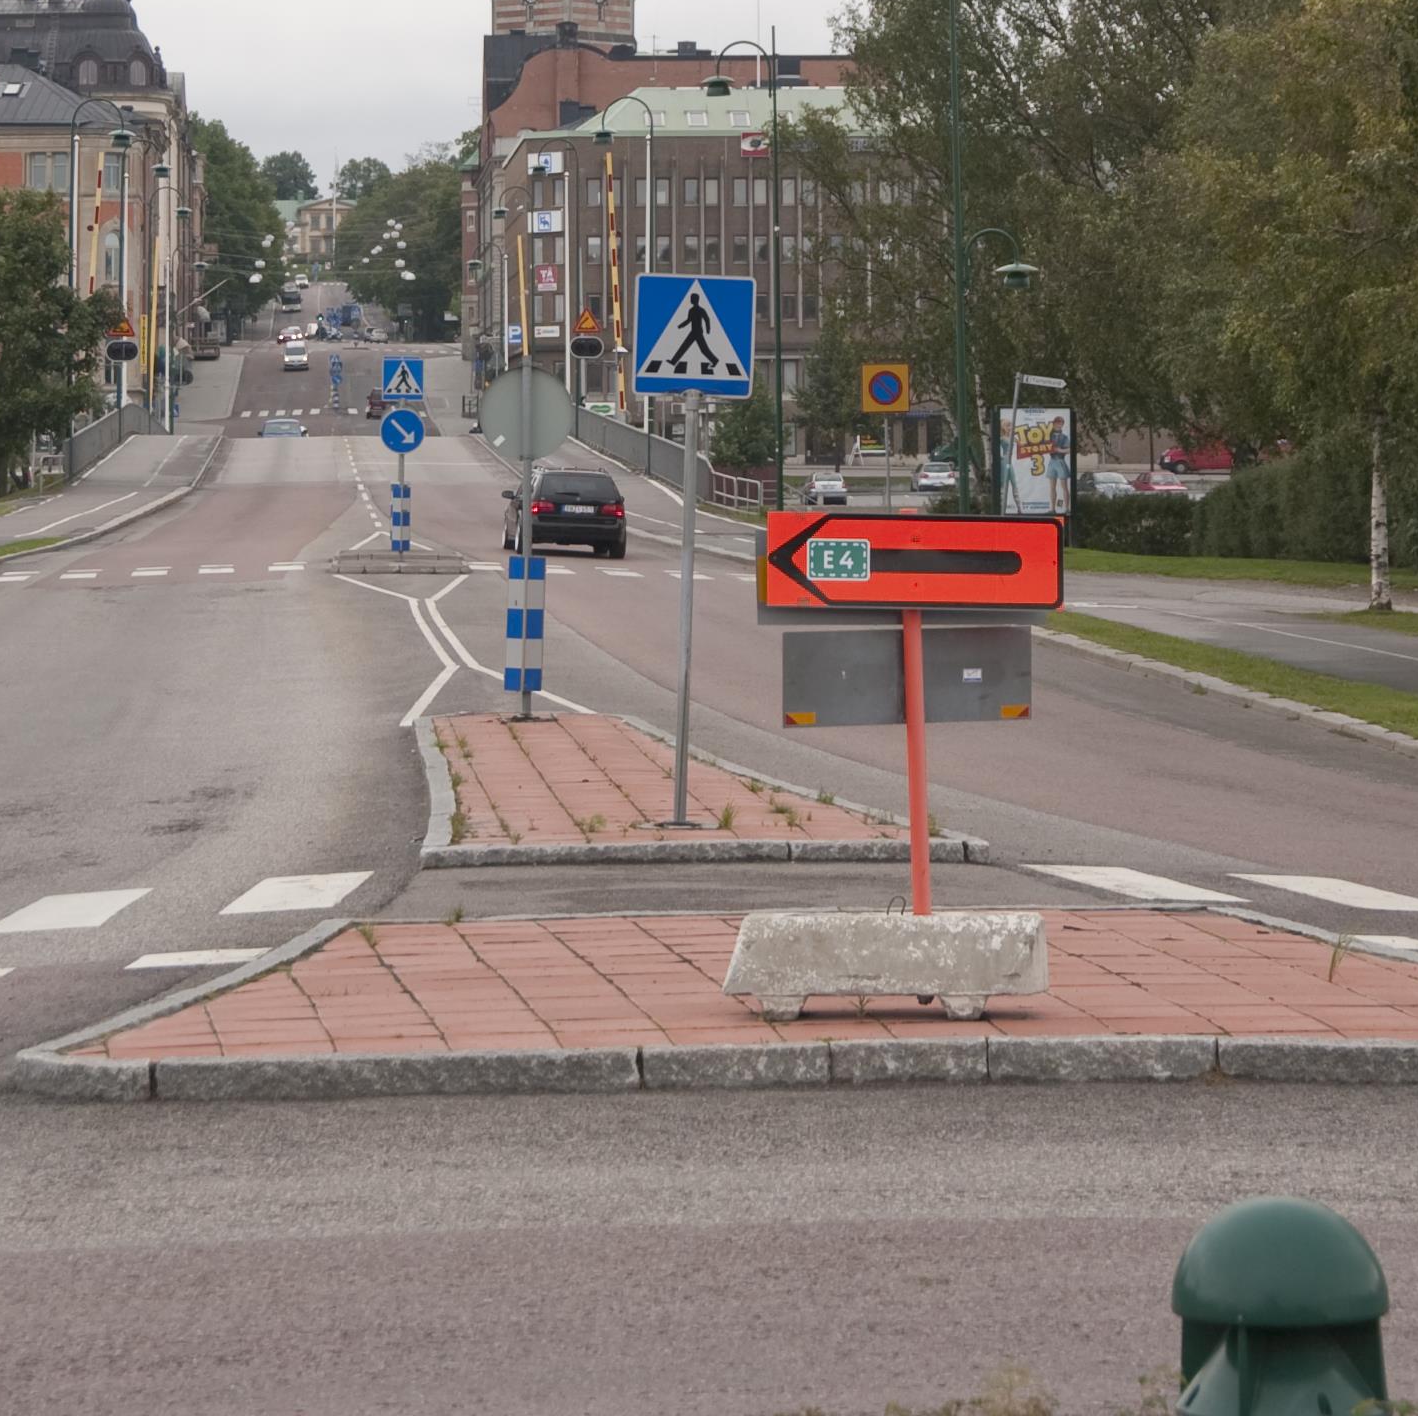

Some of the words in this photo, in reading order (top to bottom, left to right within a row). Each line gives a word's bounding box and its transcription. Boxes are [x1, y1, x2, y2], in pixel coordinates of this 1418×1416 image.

[1014, 421, 1054, 446] TOY
[1019, 443, 1054, 454] STORY
[1030, 453, 1045, 476] 3
